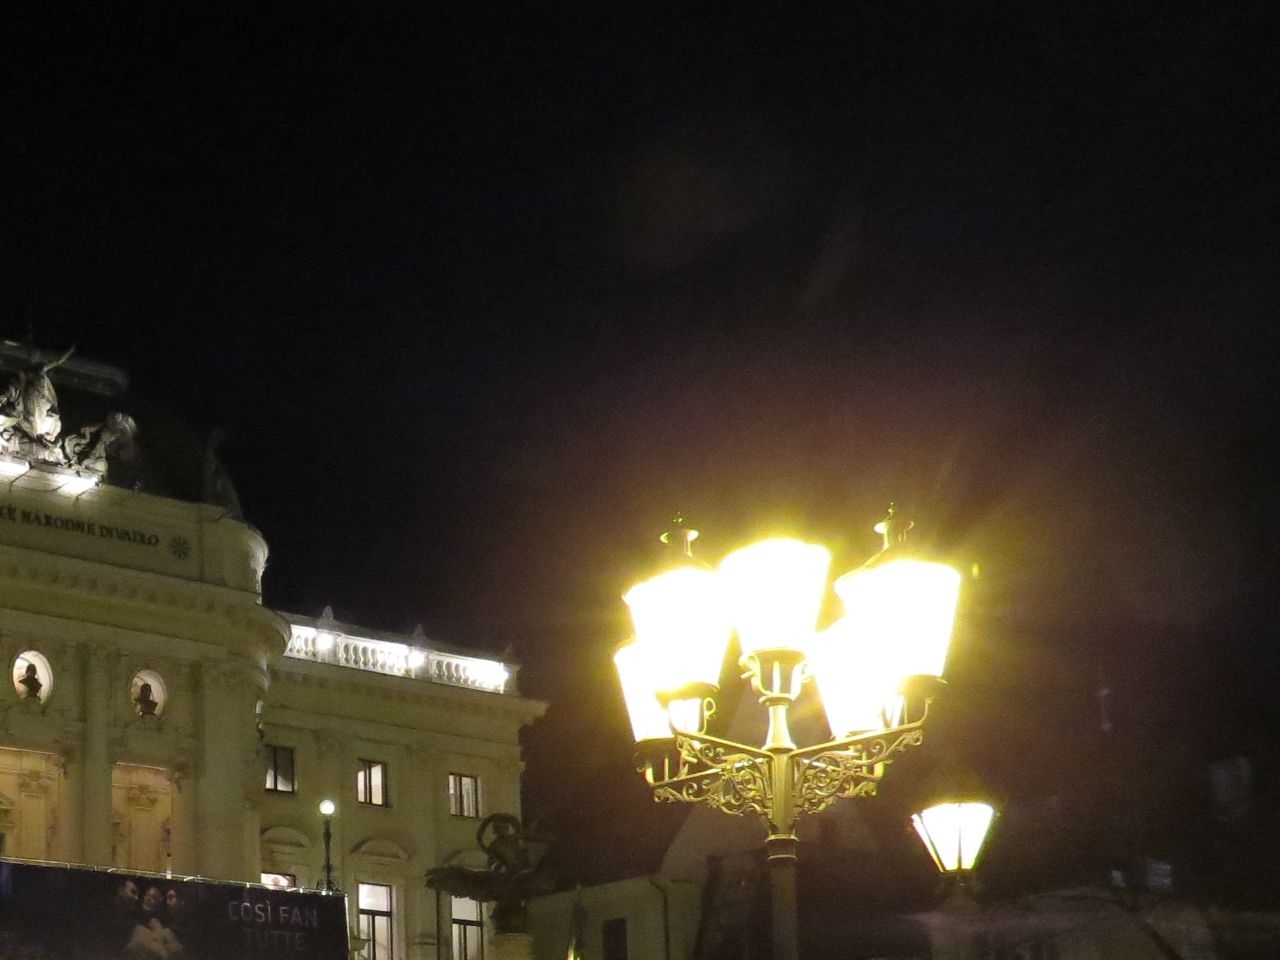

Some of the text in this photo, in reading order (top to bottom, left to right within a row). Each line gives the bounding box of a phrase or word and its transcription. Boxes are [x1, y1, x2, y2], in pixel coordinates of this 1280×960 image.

[99, 524, 159, 546] DIVADLO
[278, 905, 320, 928] FAN
[243, 928, 306, 952] TUTTE
